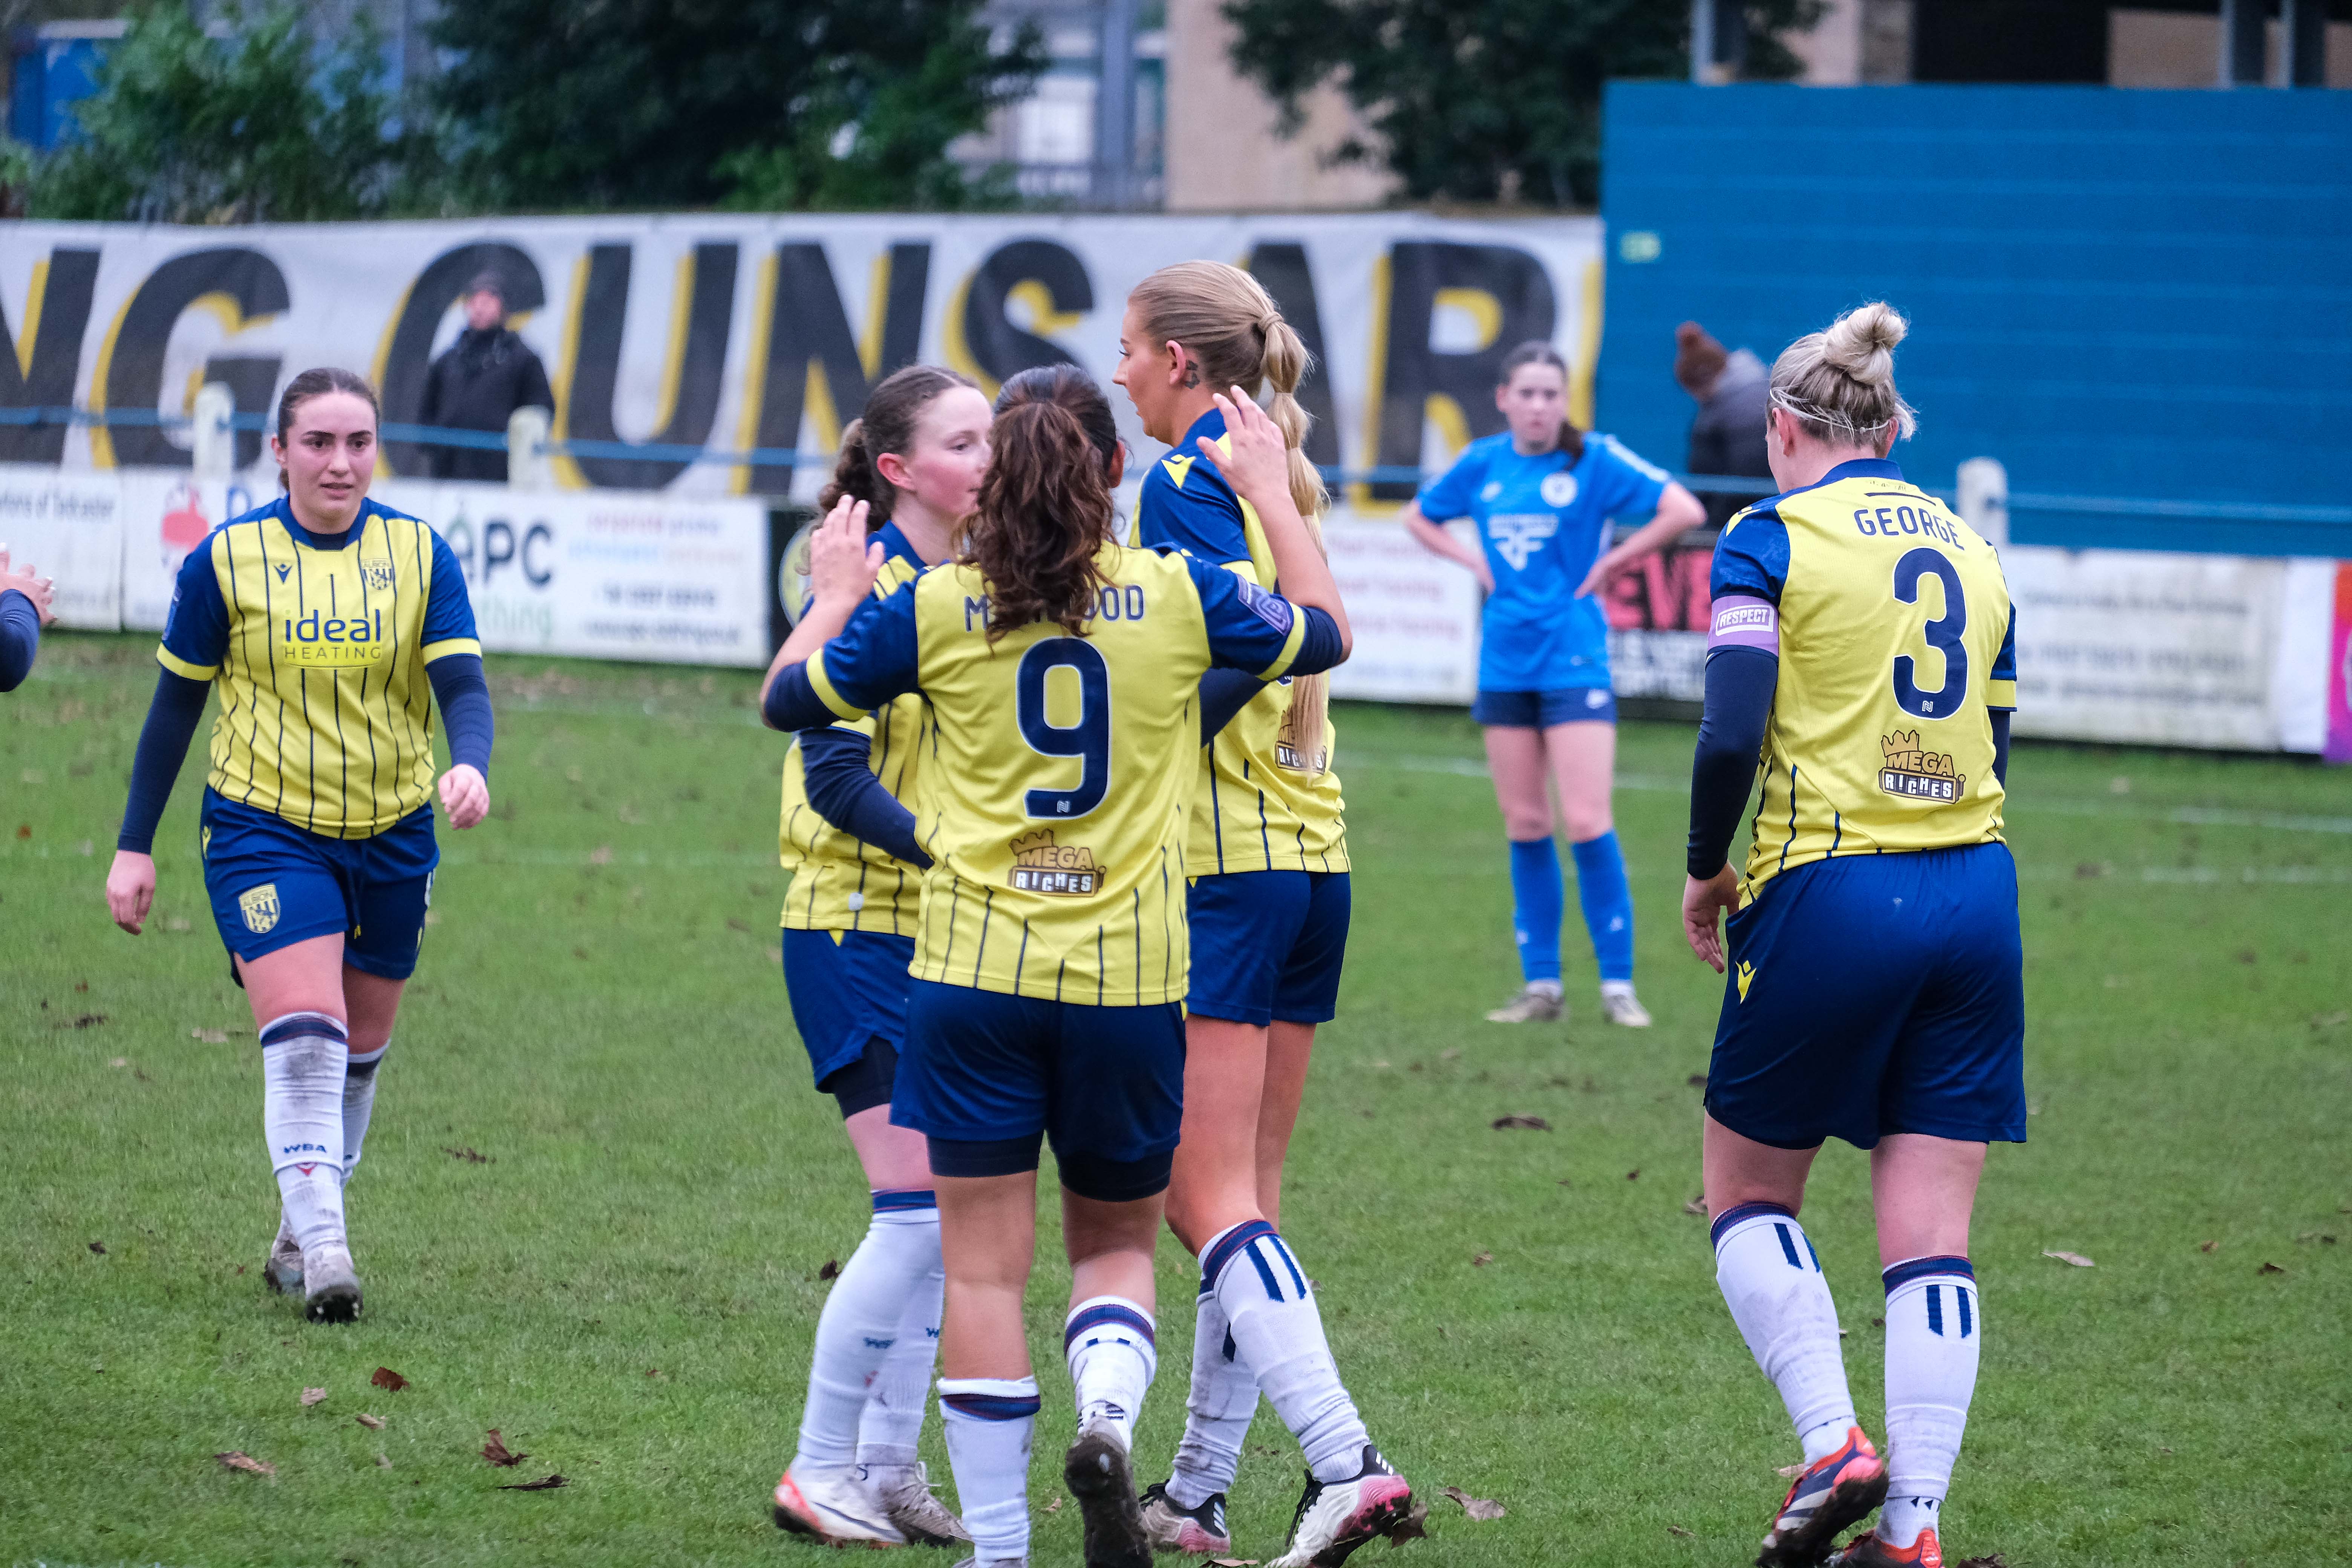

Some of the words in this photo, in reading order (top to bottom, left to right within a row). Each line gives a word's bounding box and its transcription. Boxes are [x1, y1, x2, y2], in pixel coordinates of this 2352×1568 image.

[1853, 506, 1965, 551] GEORGE
[285, 609, 380, 642] ideal
[1720, 609, 1767, 628] RESPECT
[1892, 546, 1969, 721] 3
[285, 646, 381, 659] HEATING
[1015, 635, 1112, 820] 9
[1886, 750, 1955, 777] MEGA
[1885, 773, 1952, 798] RICHES
[1017, 846, 1094, 869] MEGA
[1015, 871, 1093, 893] RICHES
